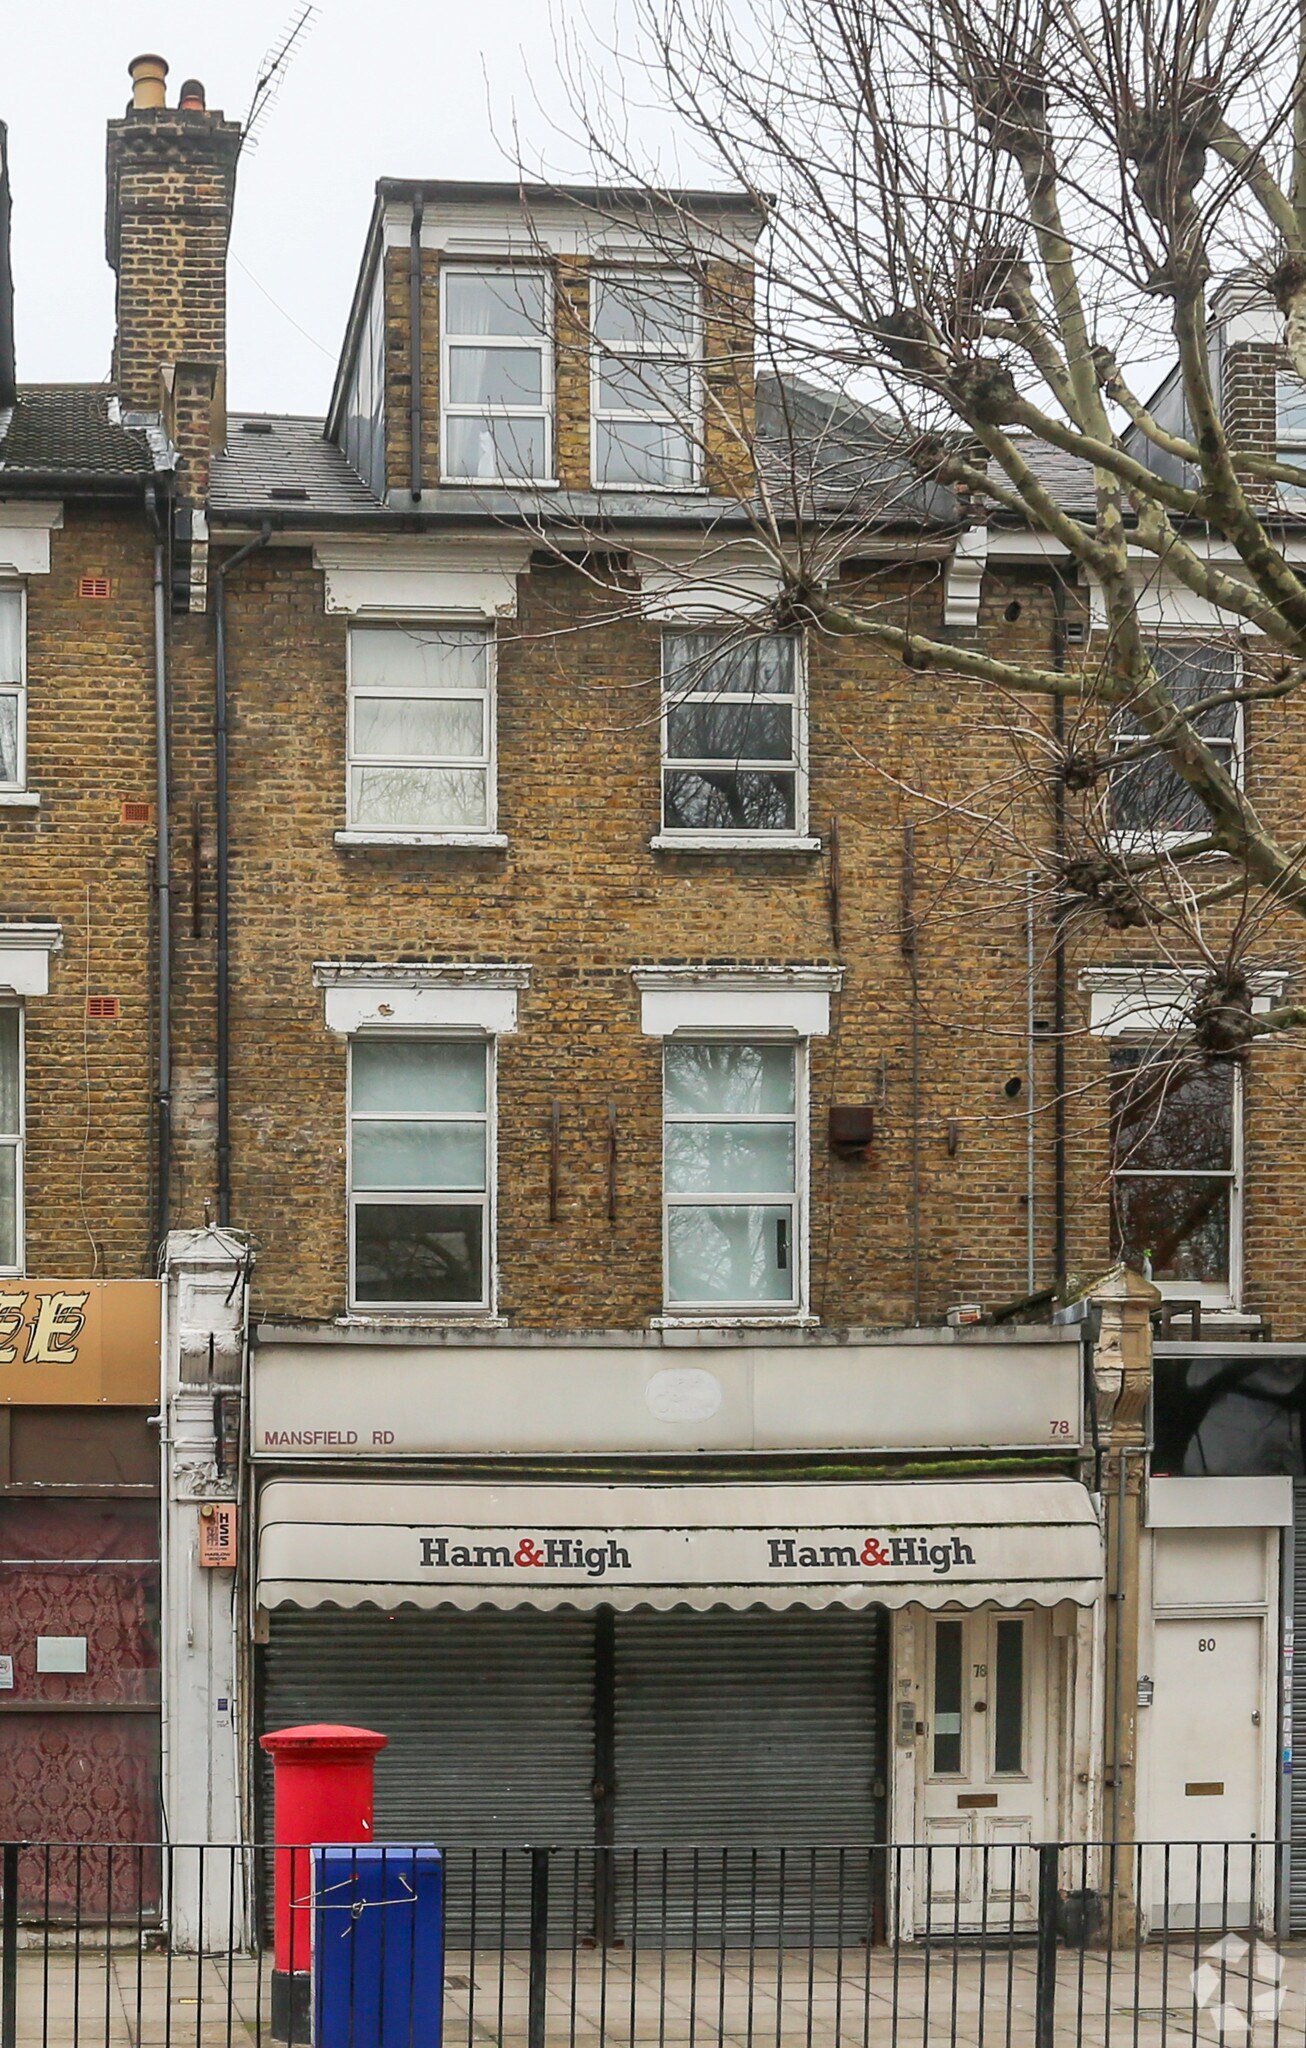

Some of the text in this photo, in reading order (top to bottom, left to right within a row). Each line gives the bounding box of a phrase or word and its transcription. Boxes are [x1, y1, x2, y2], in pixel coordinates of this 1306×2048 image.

[1049, 1420, 1070, 1435] 78
[264, 1430, 395, 1445] MANSFIELD RD
[419, 1537, 632, 1577] Ham&High
[767, 1536, 977, 1574] Ham&High
[1198, 1638, 1216, 1653] 80
[973, 1664, 988, 1678] 78
